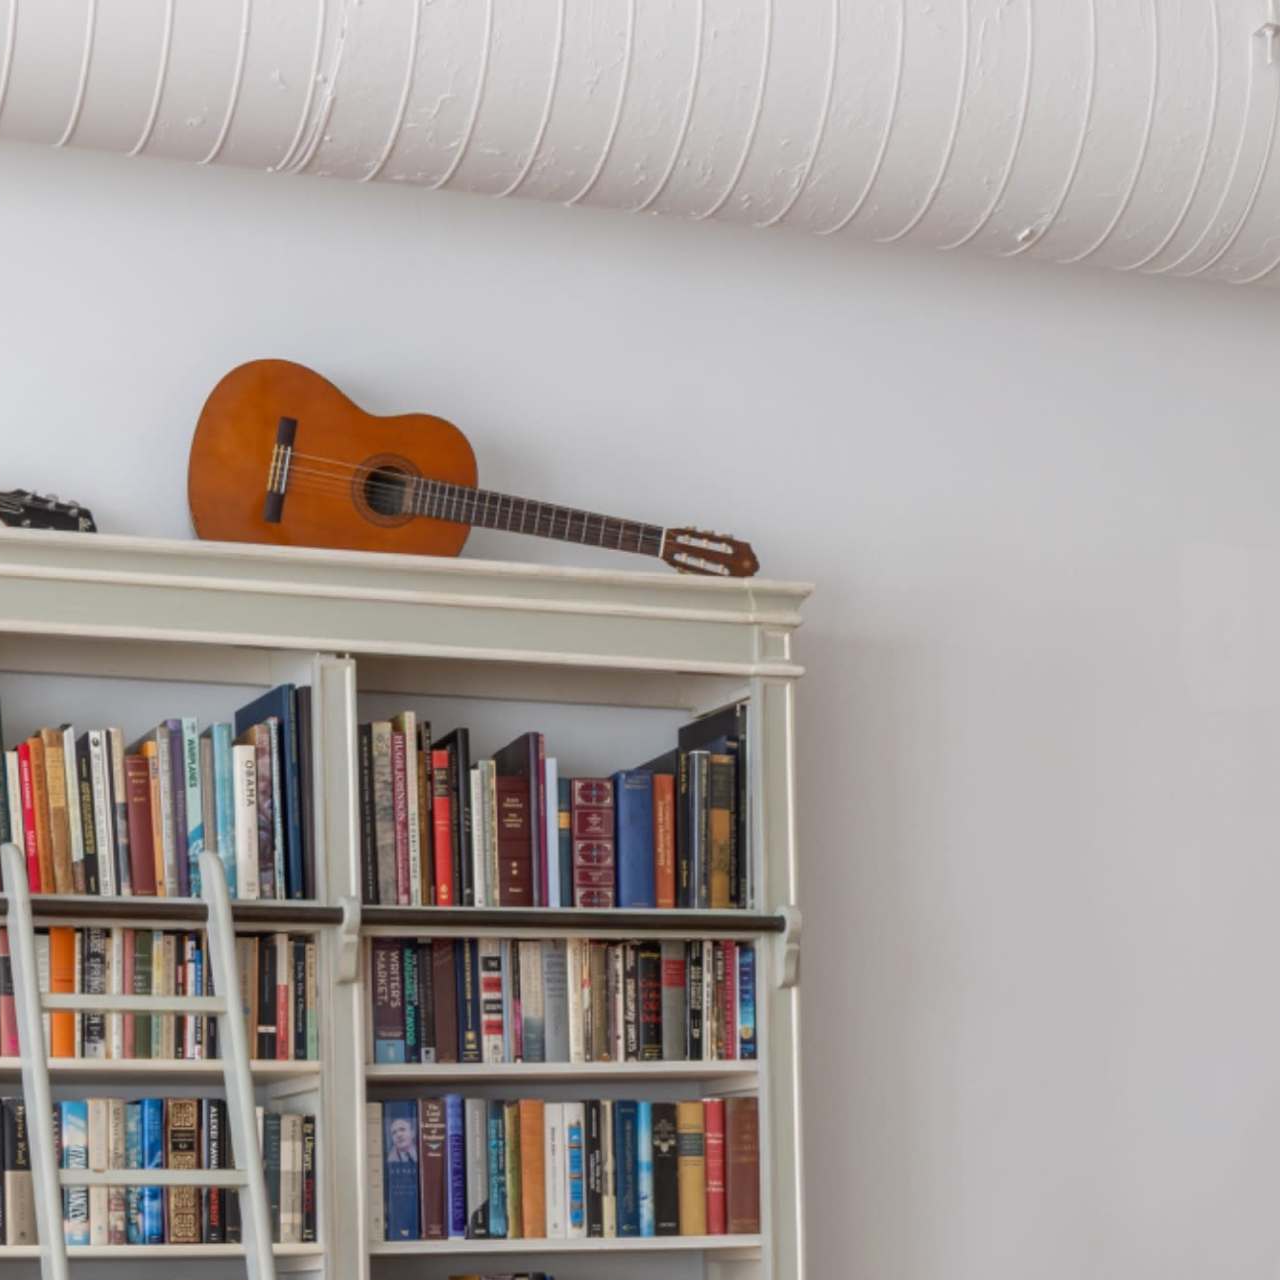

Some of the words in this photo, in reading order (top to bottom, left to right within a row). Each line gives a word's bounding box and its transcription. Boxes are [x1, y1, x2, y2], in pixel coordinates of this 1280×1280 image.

[245, 760, 256, 807] OBAMA
[388, 950, 402, 1008] WRITER'S
[209, 1106, 219, 1139] ALEXEI
[16, 1141, 28, 1166] Woolf
